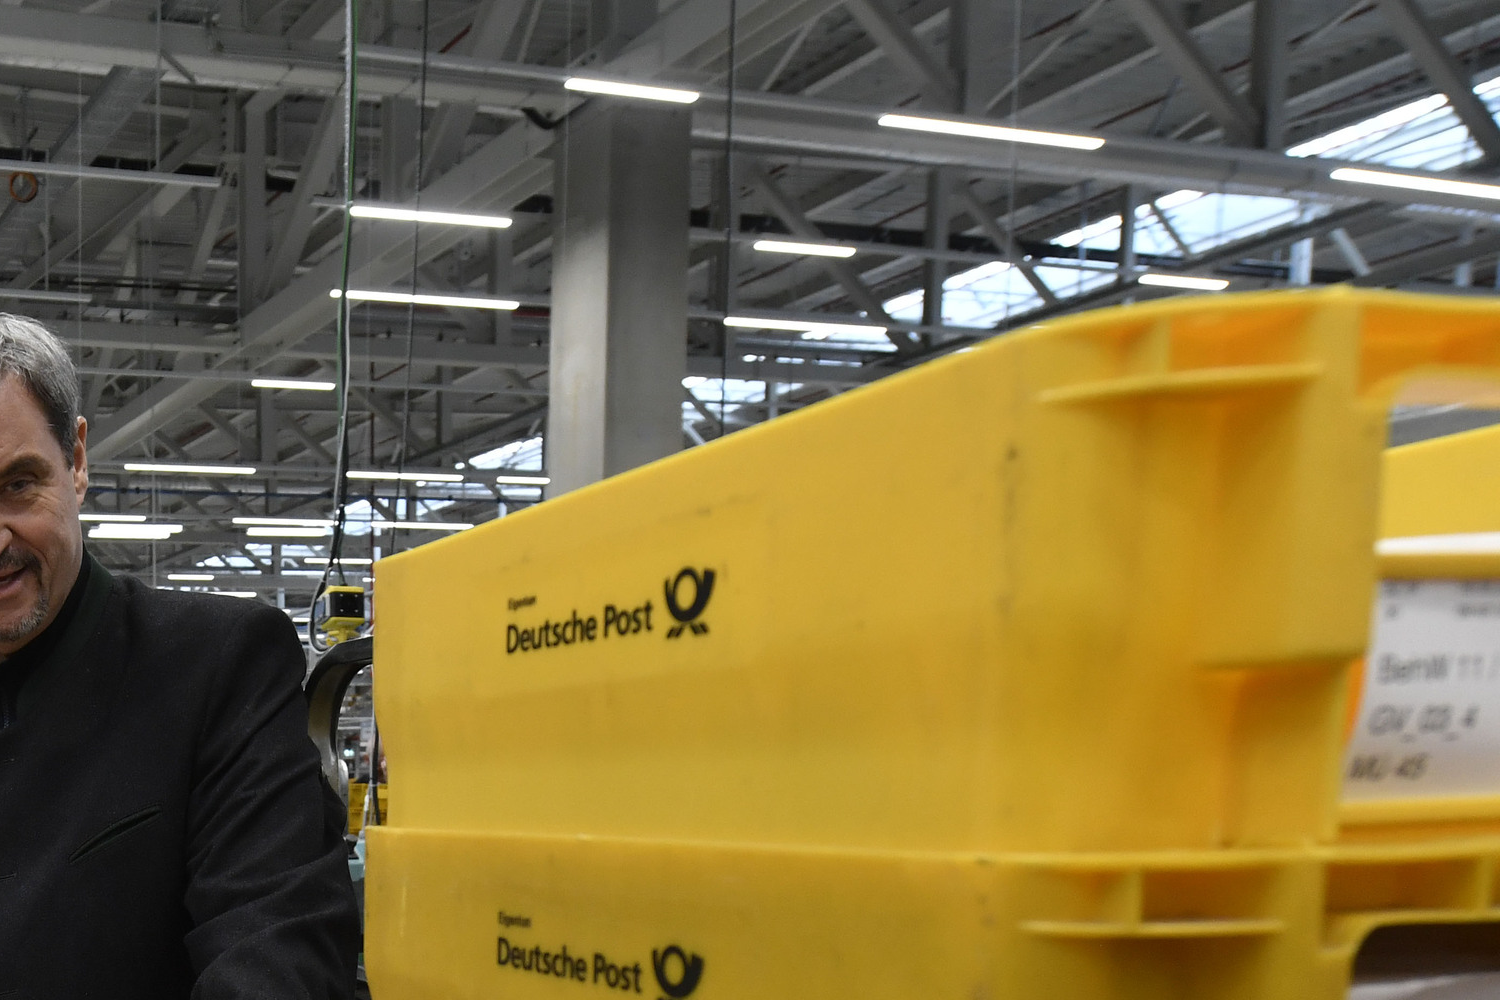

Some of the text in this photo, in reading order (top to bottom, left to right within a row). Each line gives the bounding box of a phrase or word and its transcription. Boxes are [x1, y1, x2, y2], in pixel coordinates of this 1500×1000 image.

[506, 598, 654, 655] Deutsche Post
[496, 936, 643, 994] Deutsche Post
